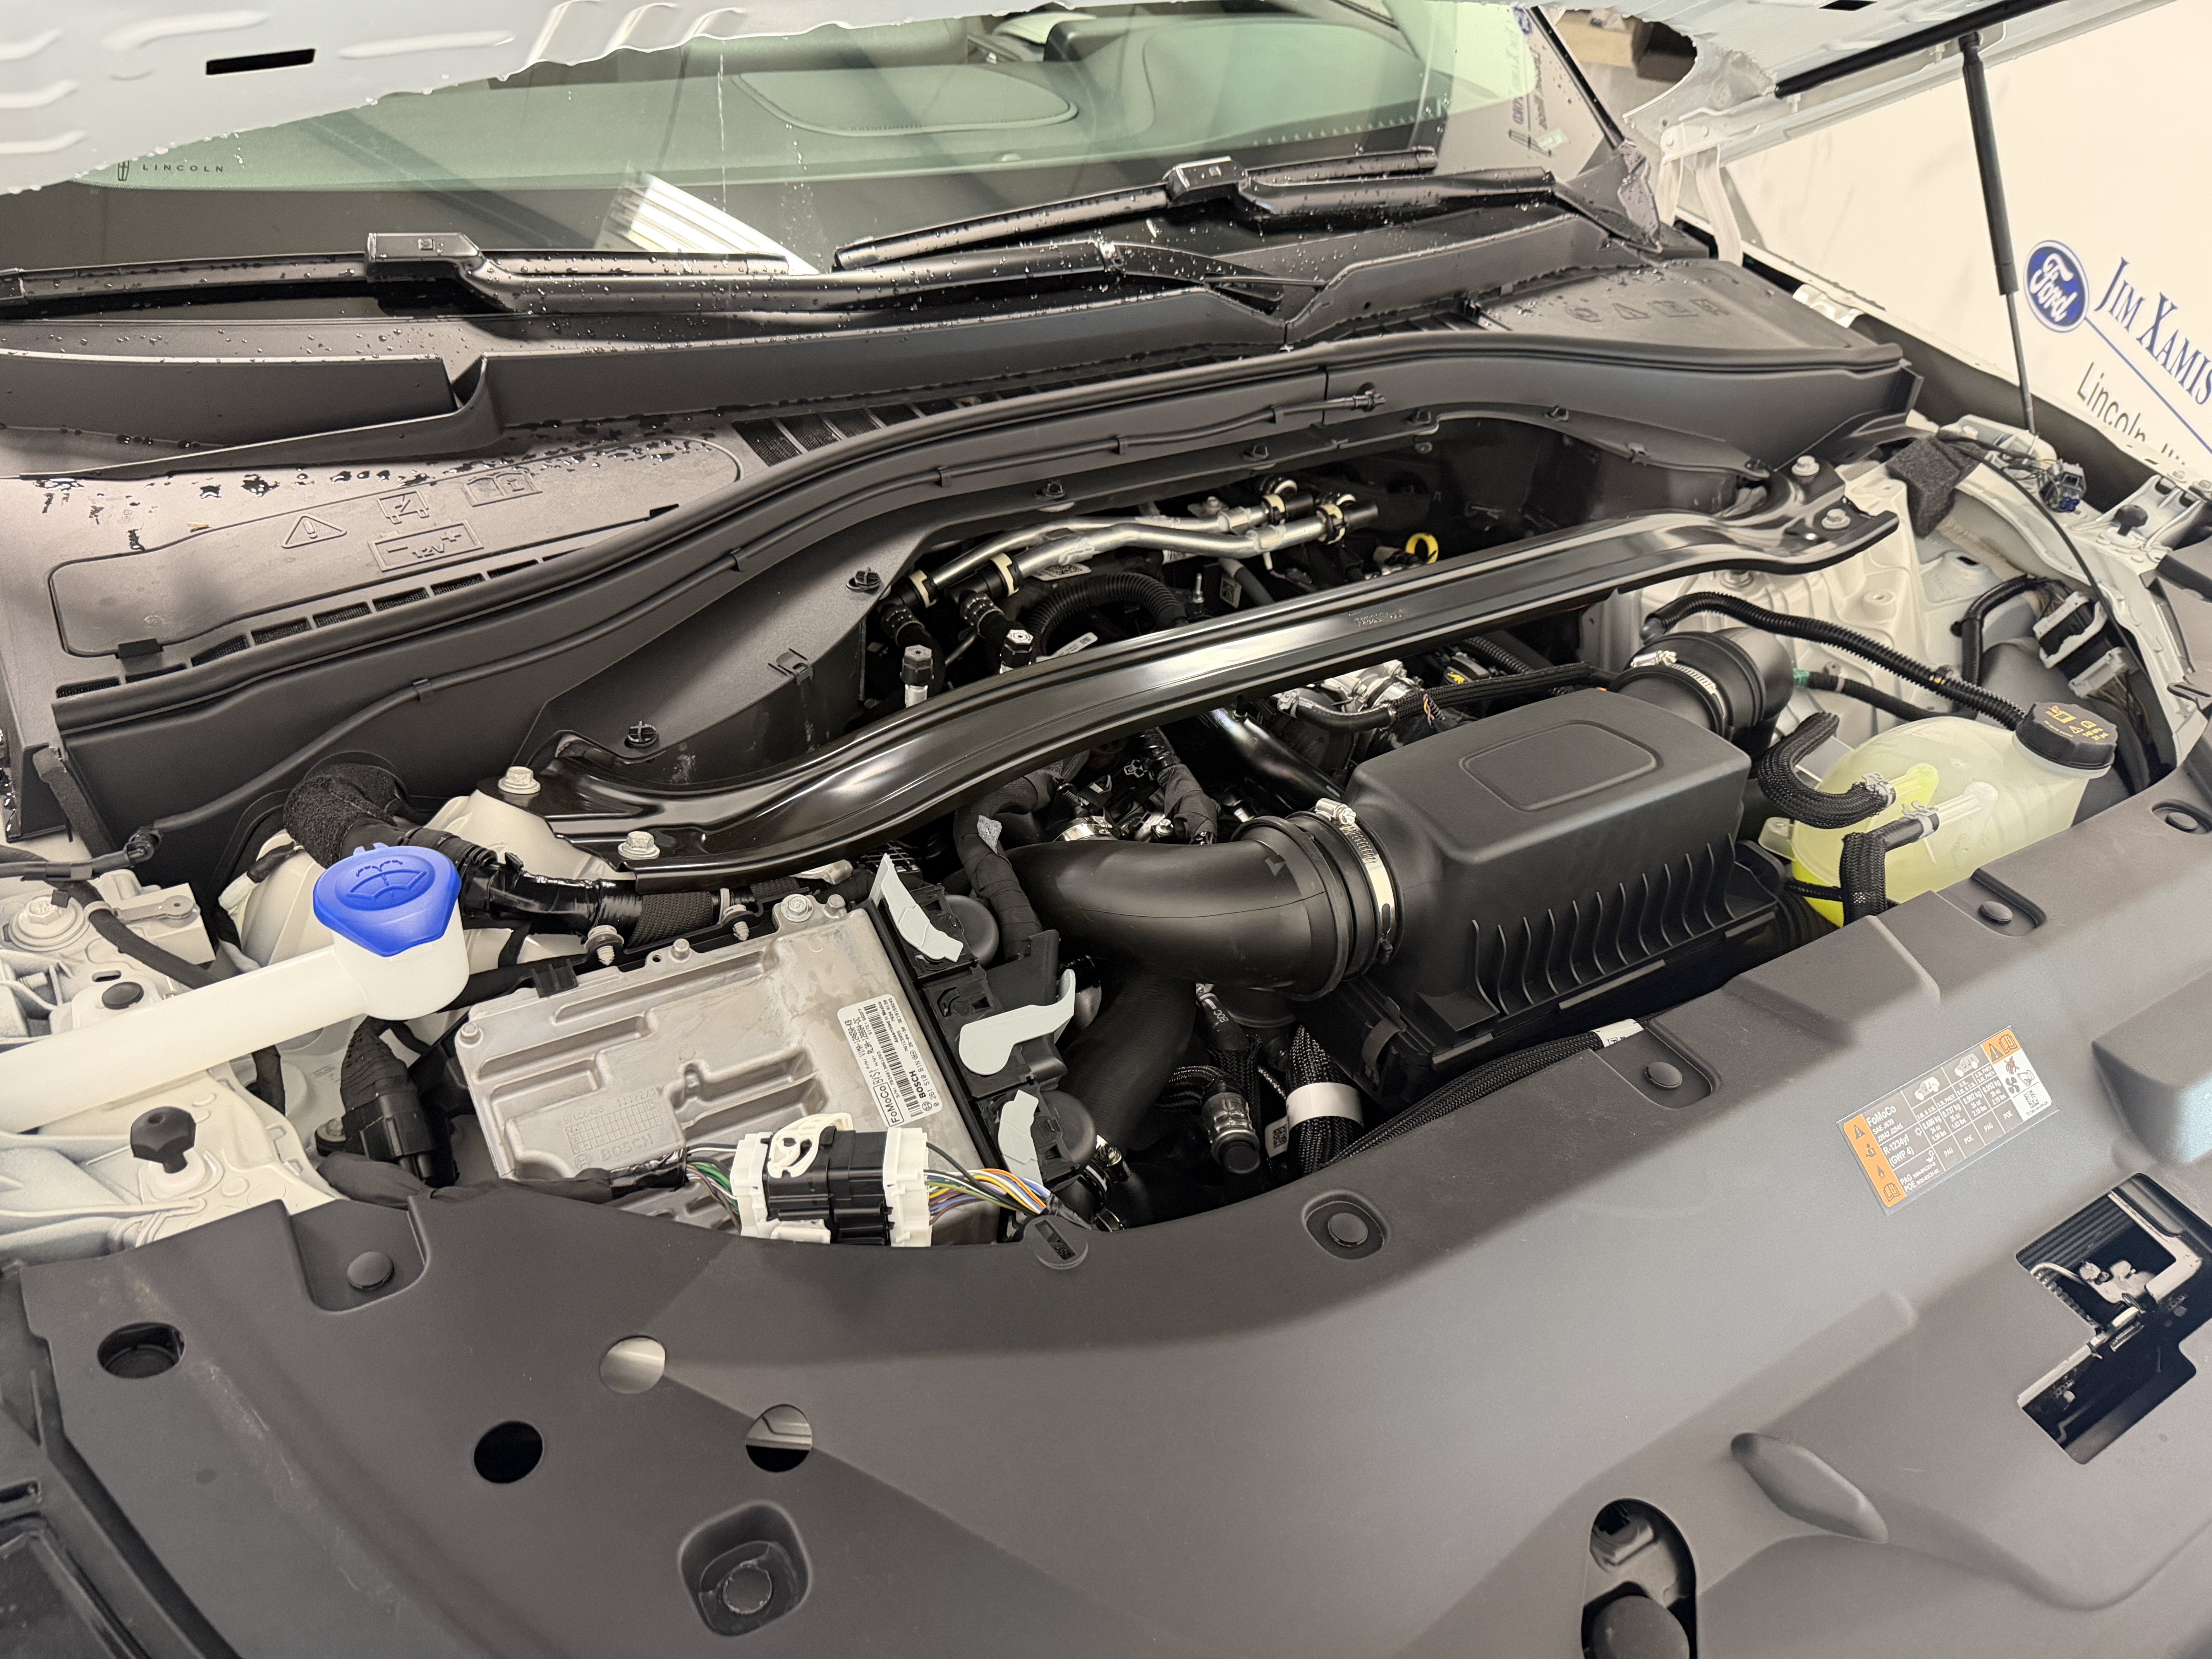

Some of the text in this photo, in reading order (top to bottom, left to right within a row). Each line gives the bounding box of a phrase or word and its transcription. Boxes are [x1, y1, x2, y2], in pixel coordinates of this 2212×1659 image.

[143, 163, 224, 173] LINCOLN
[2030, 252, 2079, 322] Ford
[2094, 256, 2212, 405] JIM XAMIS
[412, 543, 445, 558] 12V
[878, 1001, 886, 1016] Mexico
[864, 1022, 872, 1035] SITE:
[886, 1020, 898, 1042] Assembled
[909, 1070, 926, 1098] BOSCH
[927, 1089, 936, 1100] 261
[879, 1085, 900, 1123] FoMoCo
[1866, 1106, 1896, 1127] FoMoCo
[2002, 1110, 2013, 1120] POE
[1872, 1118, 1894, 1134] SAE J639
[1983, 1122, 1993, 1132] PAG
[1882, 1133, 1909, 1155] R-1234yf
[1963, 1134, 1974, 1144] POE
[600, 1133, 653, 1162] BOSCH
[1943, 1147, 1953, 1157] PAG
[1889, 1146, 1914, 1167] (GWP 4)
[1899, 1174, 1912, 1185] PAG
[1903, 1180, 1917, 1192] POE
